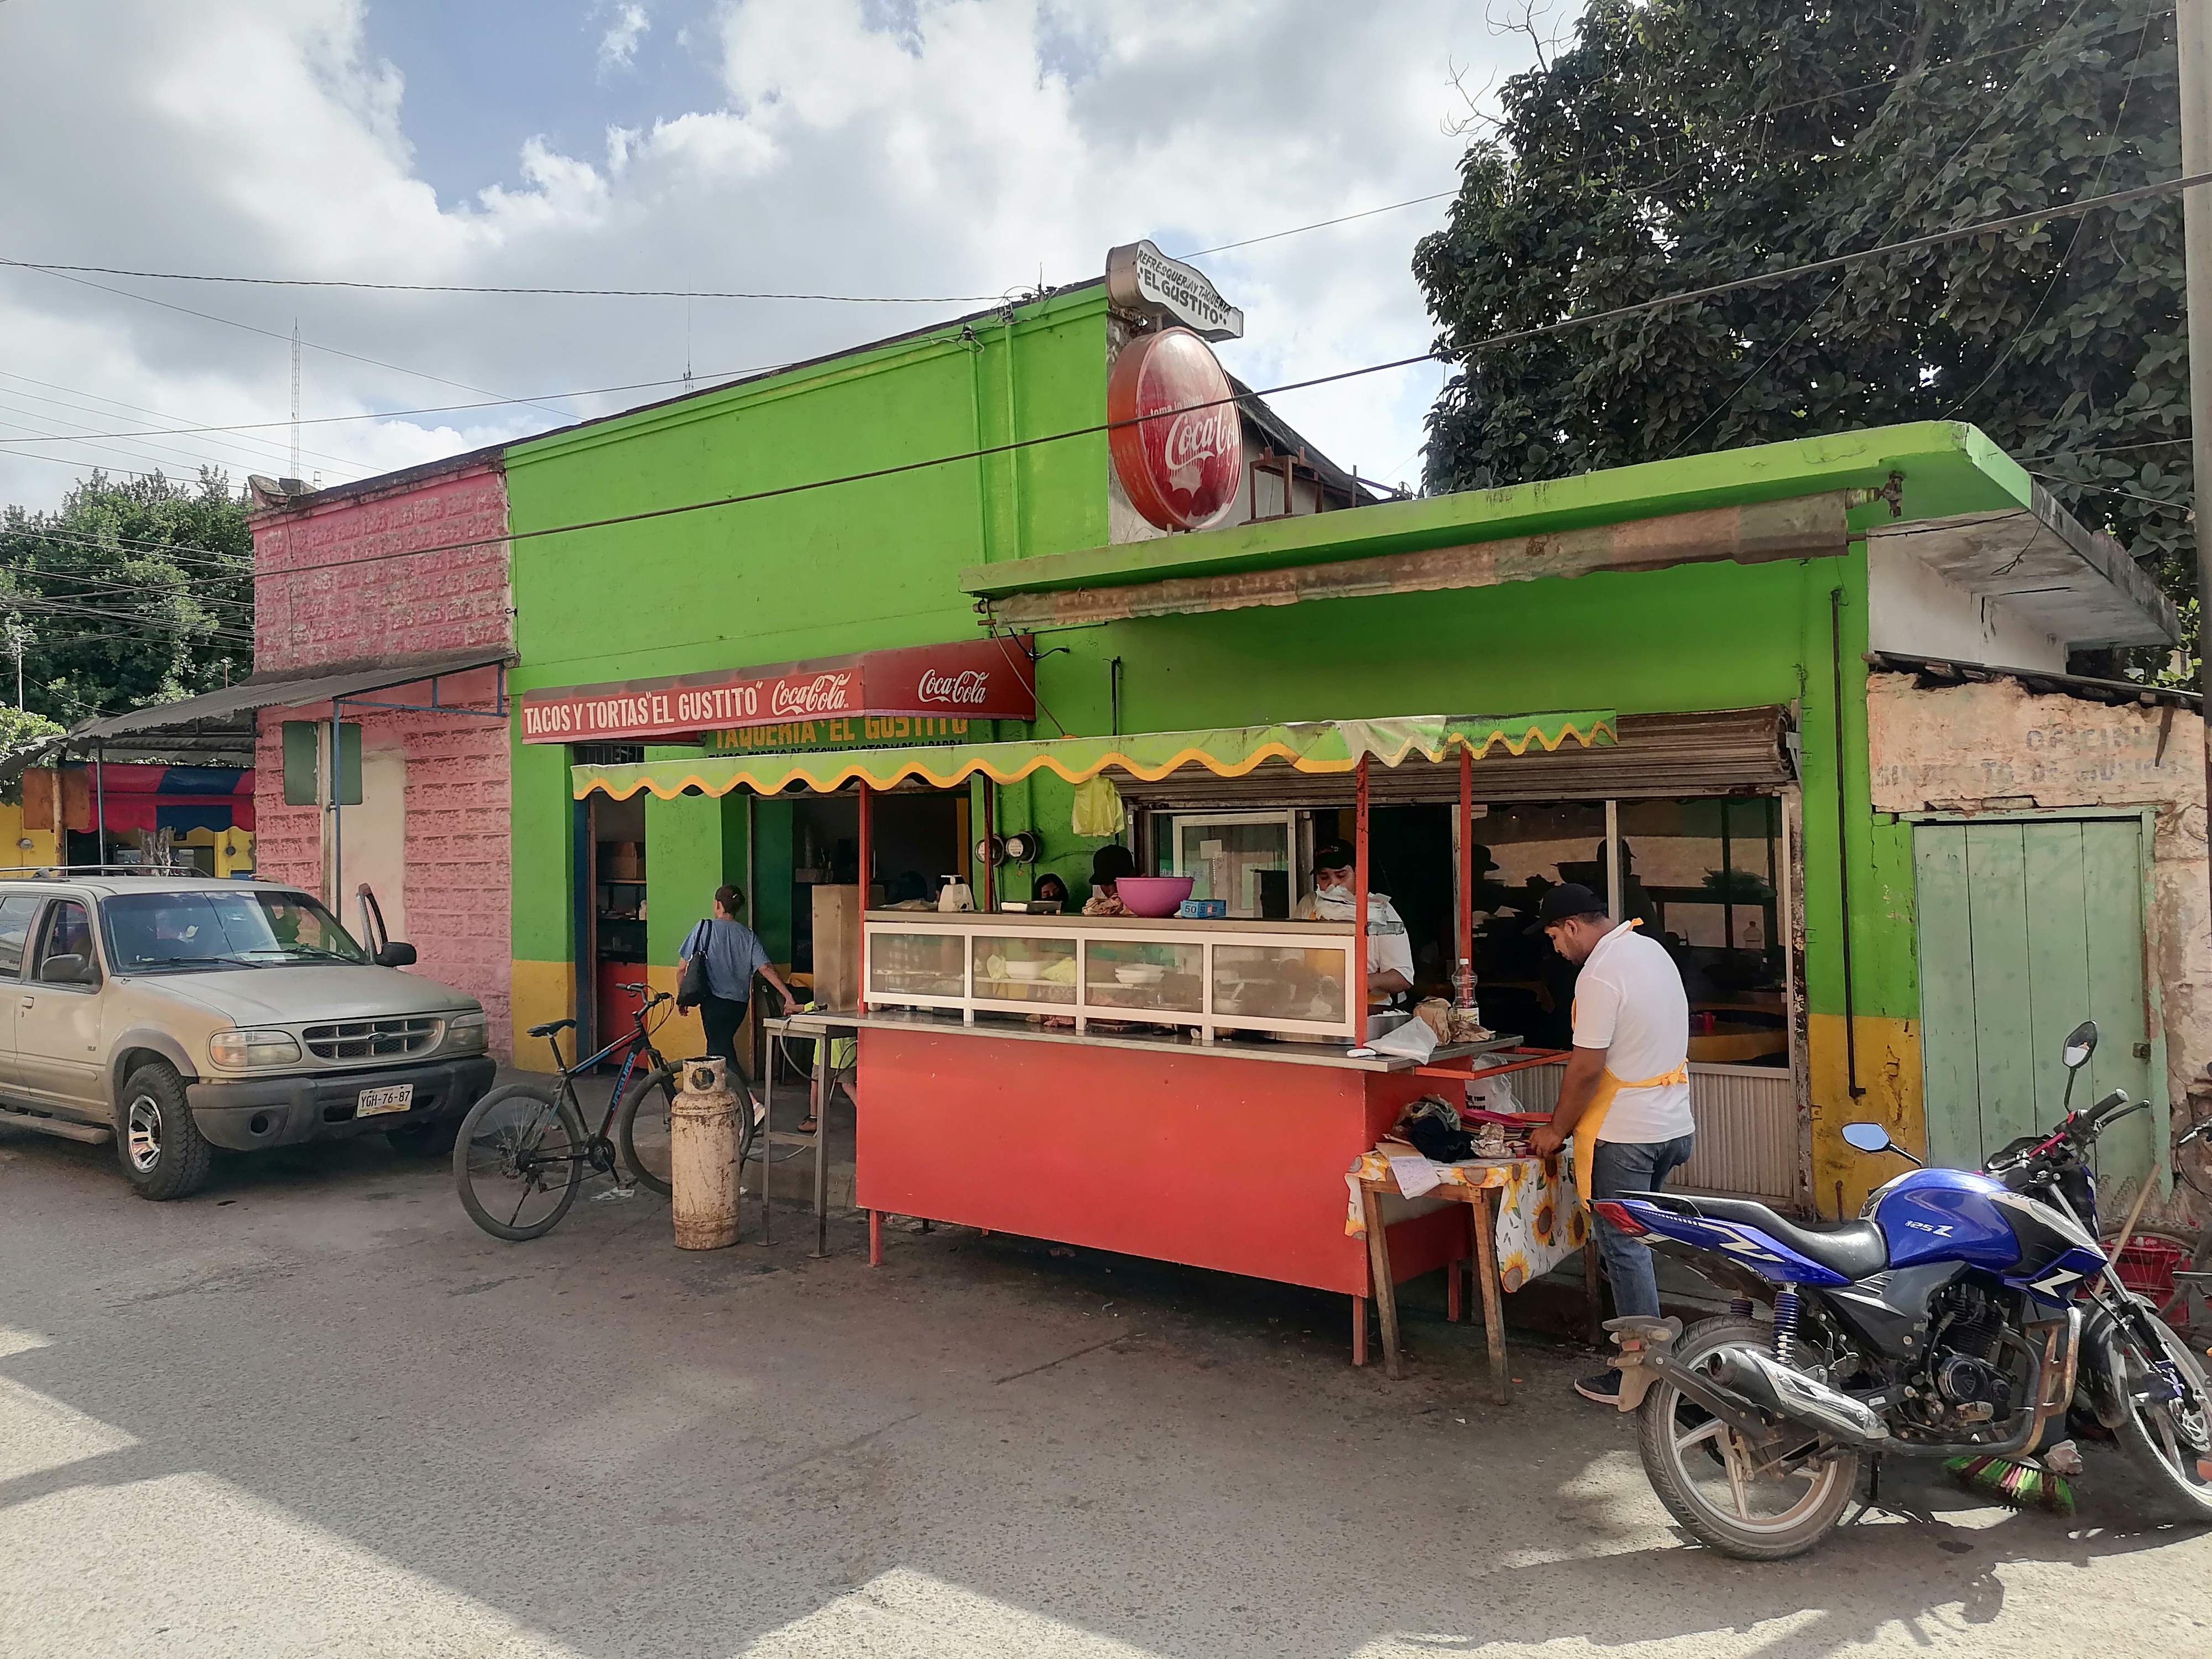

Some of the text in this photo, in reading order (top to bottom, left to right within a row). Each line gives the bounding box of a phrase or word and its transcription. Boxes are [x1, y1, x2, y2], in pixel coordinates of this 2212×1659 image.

[1191, 284, 1199, 294] Y
[524, 705, 571, 734] TACOS
[573, 703, 584, 730] Y
[586, 697, 648, 729] TORTAS
[1185, 905, 1197, 914] 50
[612, 1052, 635, 1111] JAGUAR
[361, 1091, 411, 1108] YGH-76-87
